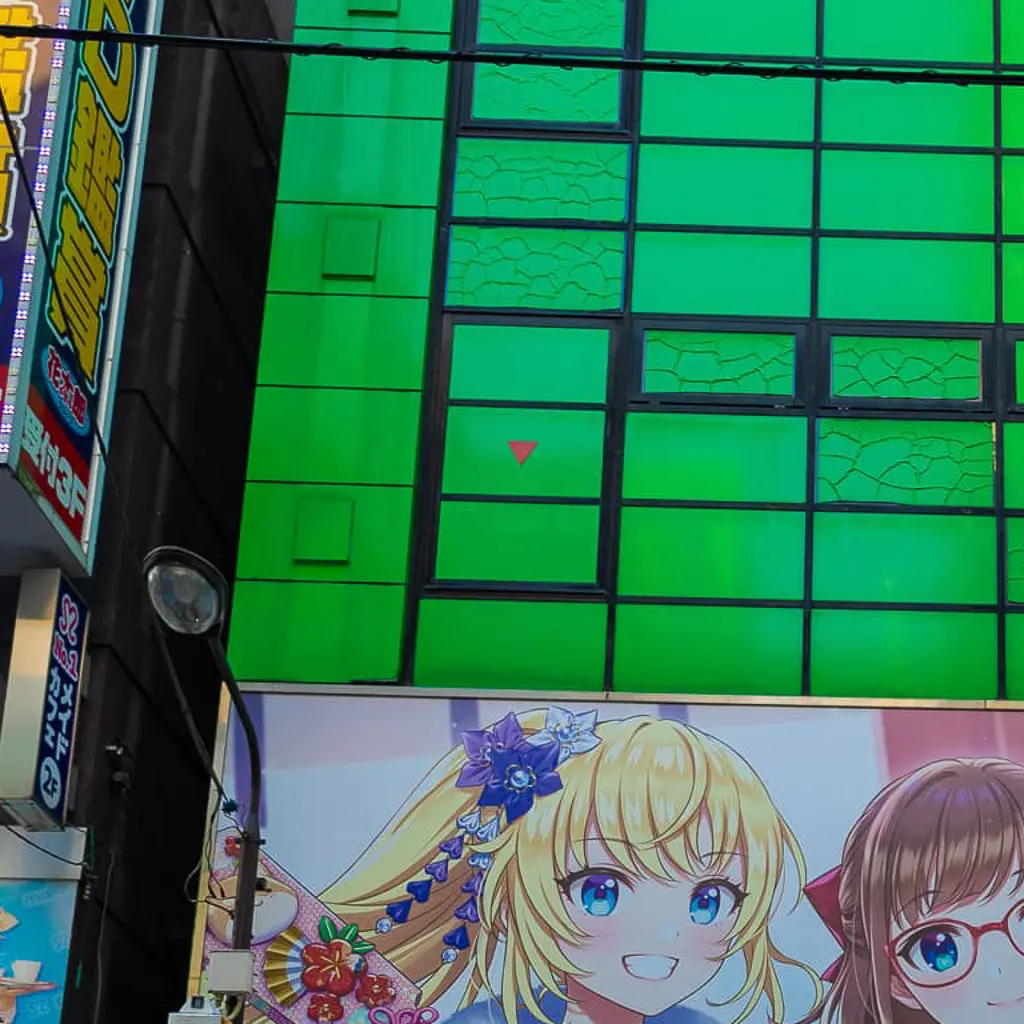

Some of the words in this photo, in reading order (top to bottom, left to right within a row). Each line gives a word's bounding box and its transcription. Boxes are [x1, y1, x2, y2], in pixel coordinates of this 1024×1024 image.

[21, 408, 88, 520] 受付3F
[55, 683, 74, 761] メイド
[42, 762, 59, 796] 2F
